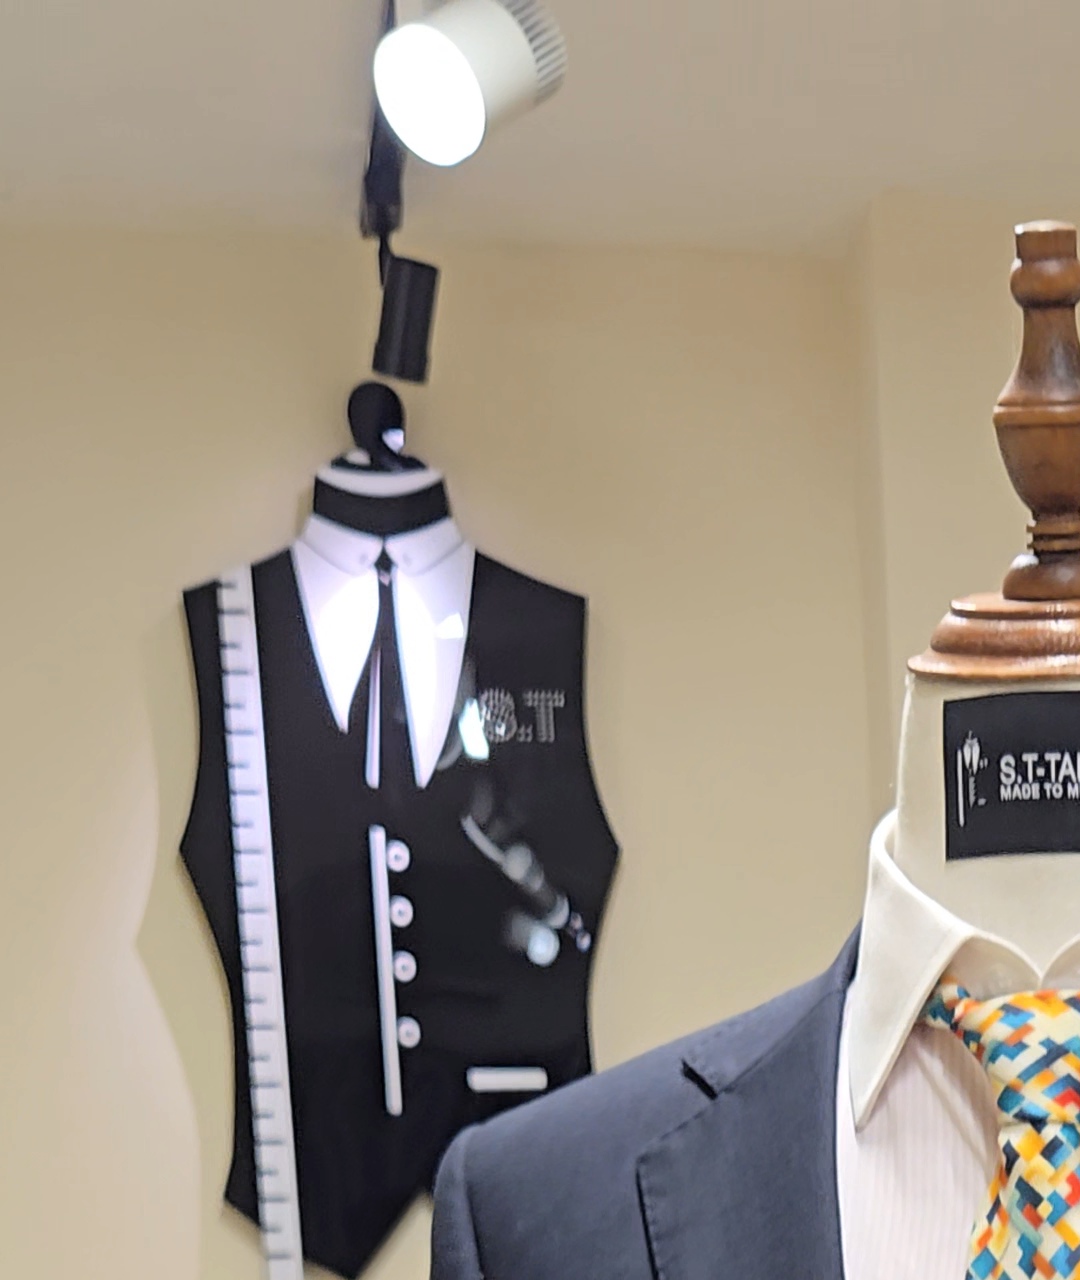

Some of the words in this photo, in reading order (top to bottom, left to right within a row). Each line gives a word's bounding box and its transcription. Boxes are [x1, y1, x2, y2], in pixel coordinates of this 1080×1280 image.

[479, 687, 566, 742] S.T
[1000, 783, 1040, 801] MADE
[1044, 782, 1063, 799] TO
